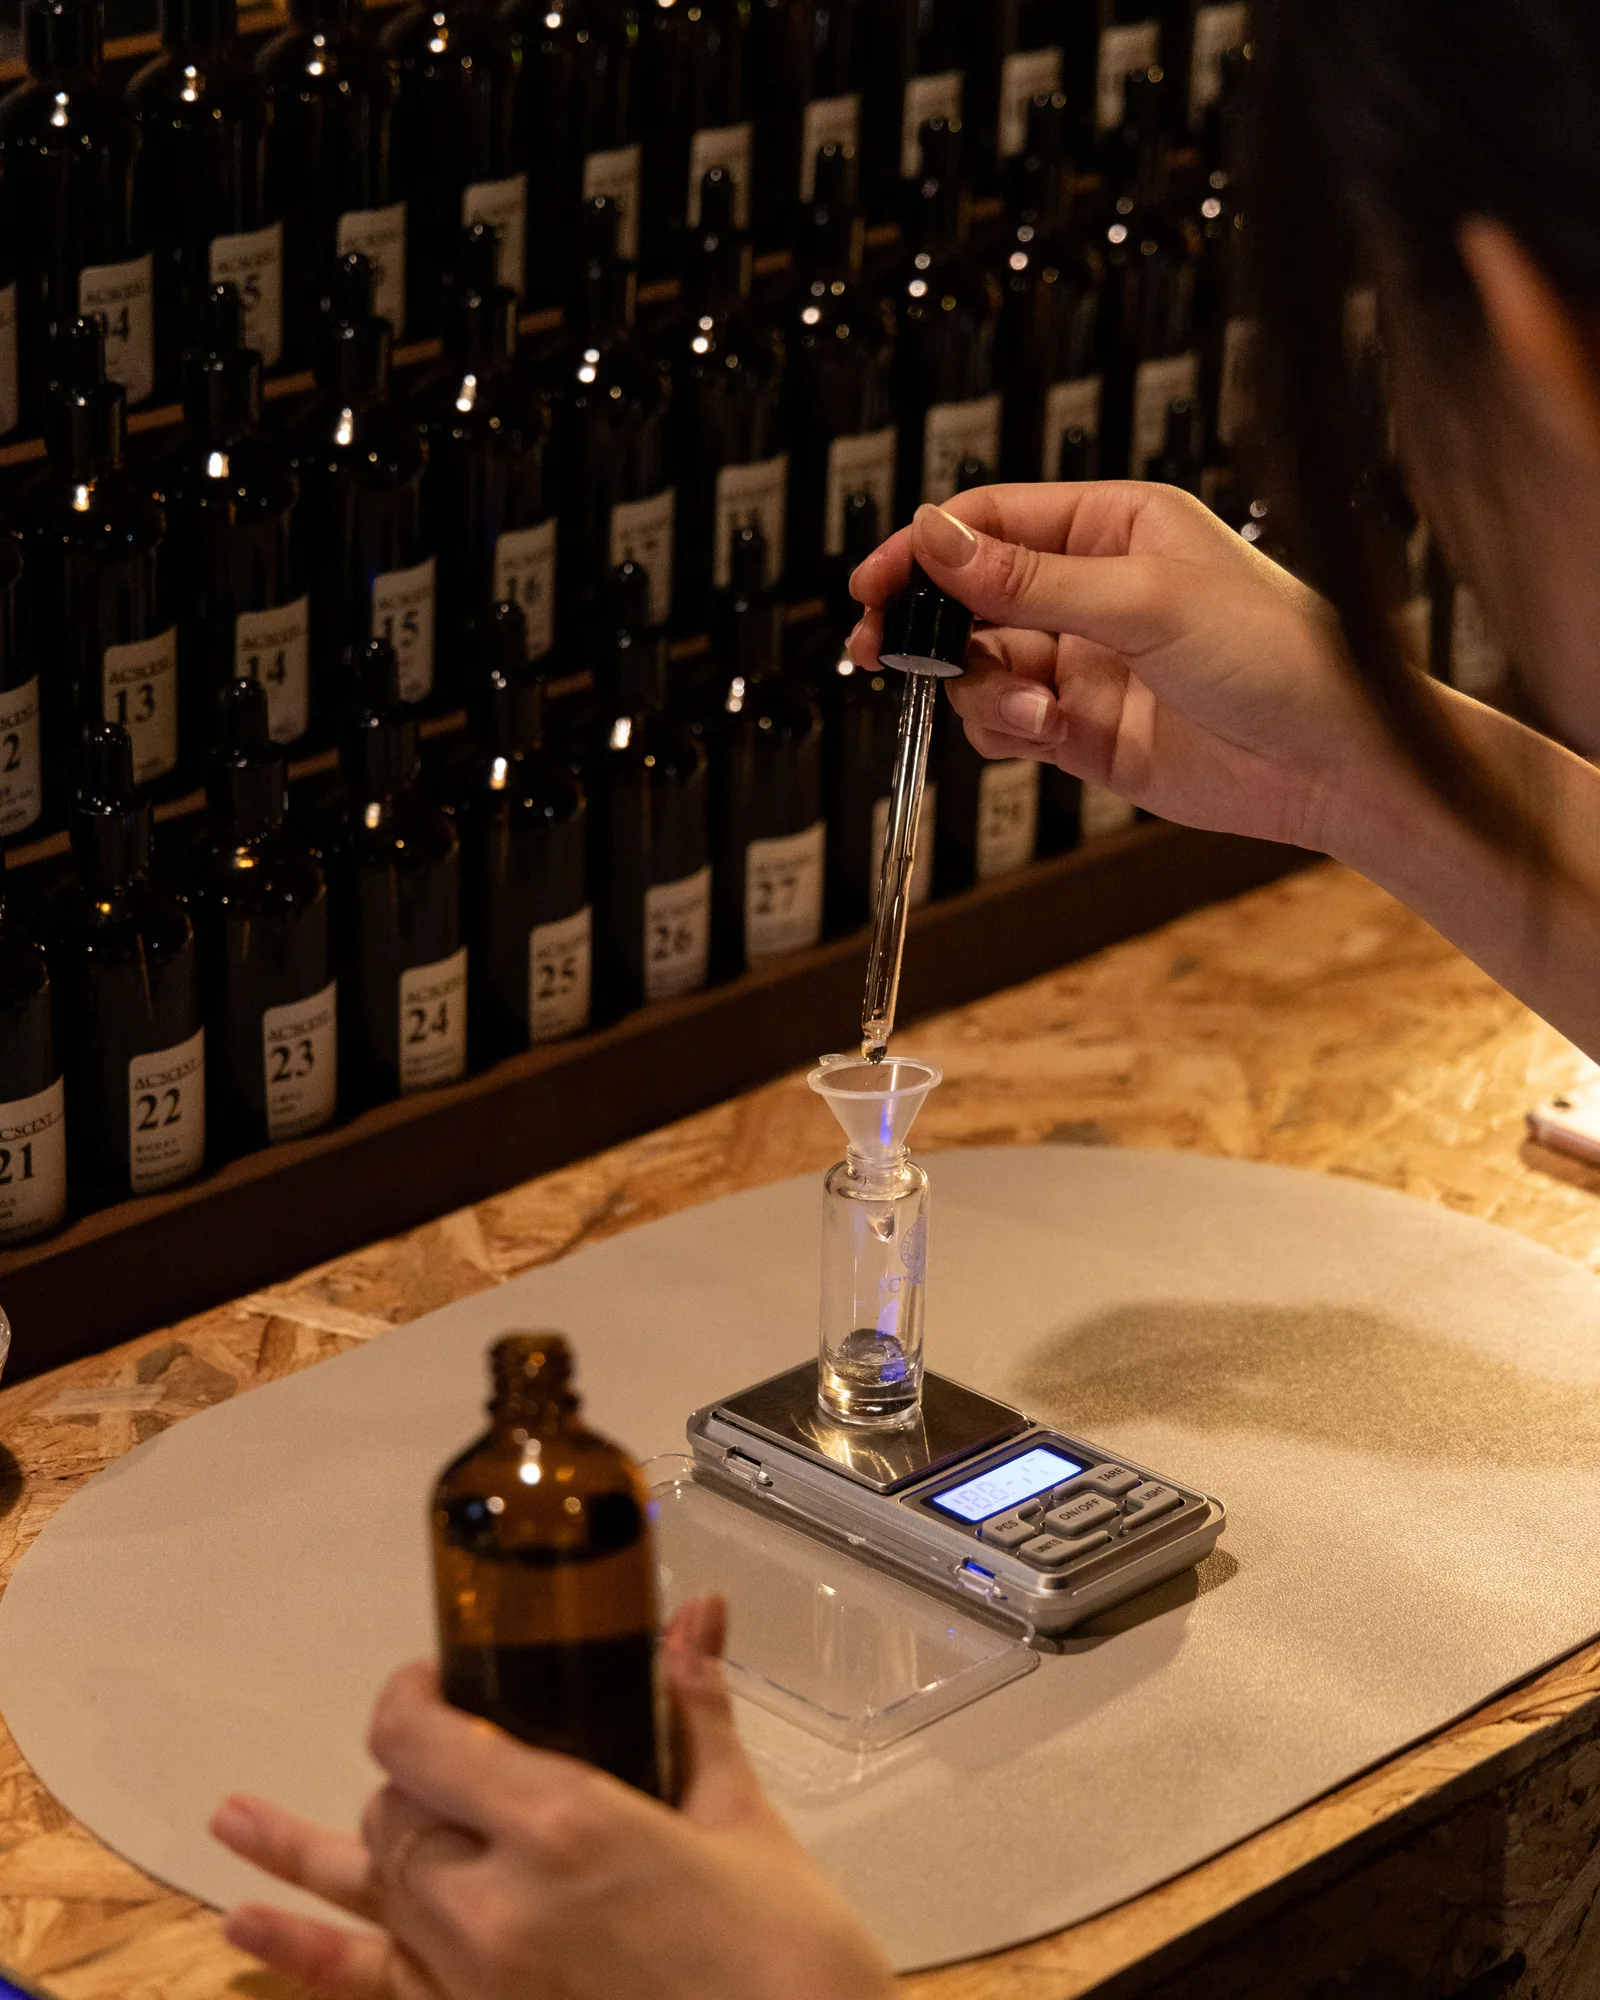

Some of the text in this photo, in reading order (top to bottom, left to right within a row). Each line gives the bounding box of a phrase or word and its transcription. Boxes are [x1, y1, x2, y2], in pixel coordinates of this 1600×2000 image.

[248, 651, 285, 685] 14
[116, 683, 154, 725] 13
[2, 733, 21, 772] 2
[539, 955, 578, 998] 25
[409, 1001, 448, 1045] 24
[271, 1039, 314, 1083] 23
[0, 1112, 53, 1139] C'SCENT
[137, 1087, 182, 1131] 22
[0, 1142, 36, 1185] 21
[1096, 1467, 1126, 1483] TARE
[1139, 1485, 1167, 1501] LIGHT
[994, 1519, 1019, 1533] PCS
[1058, 1498, 1101, 1521] ON/OFF
[1033, 1538, 1063, 1553] UNITS
